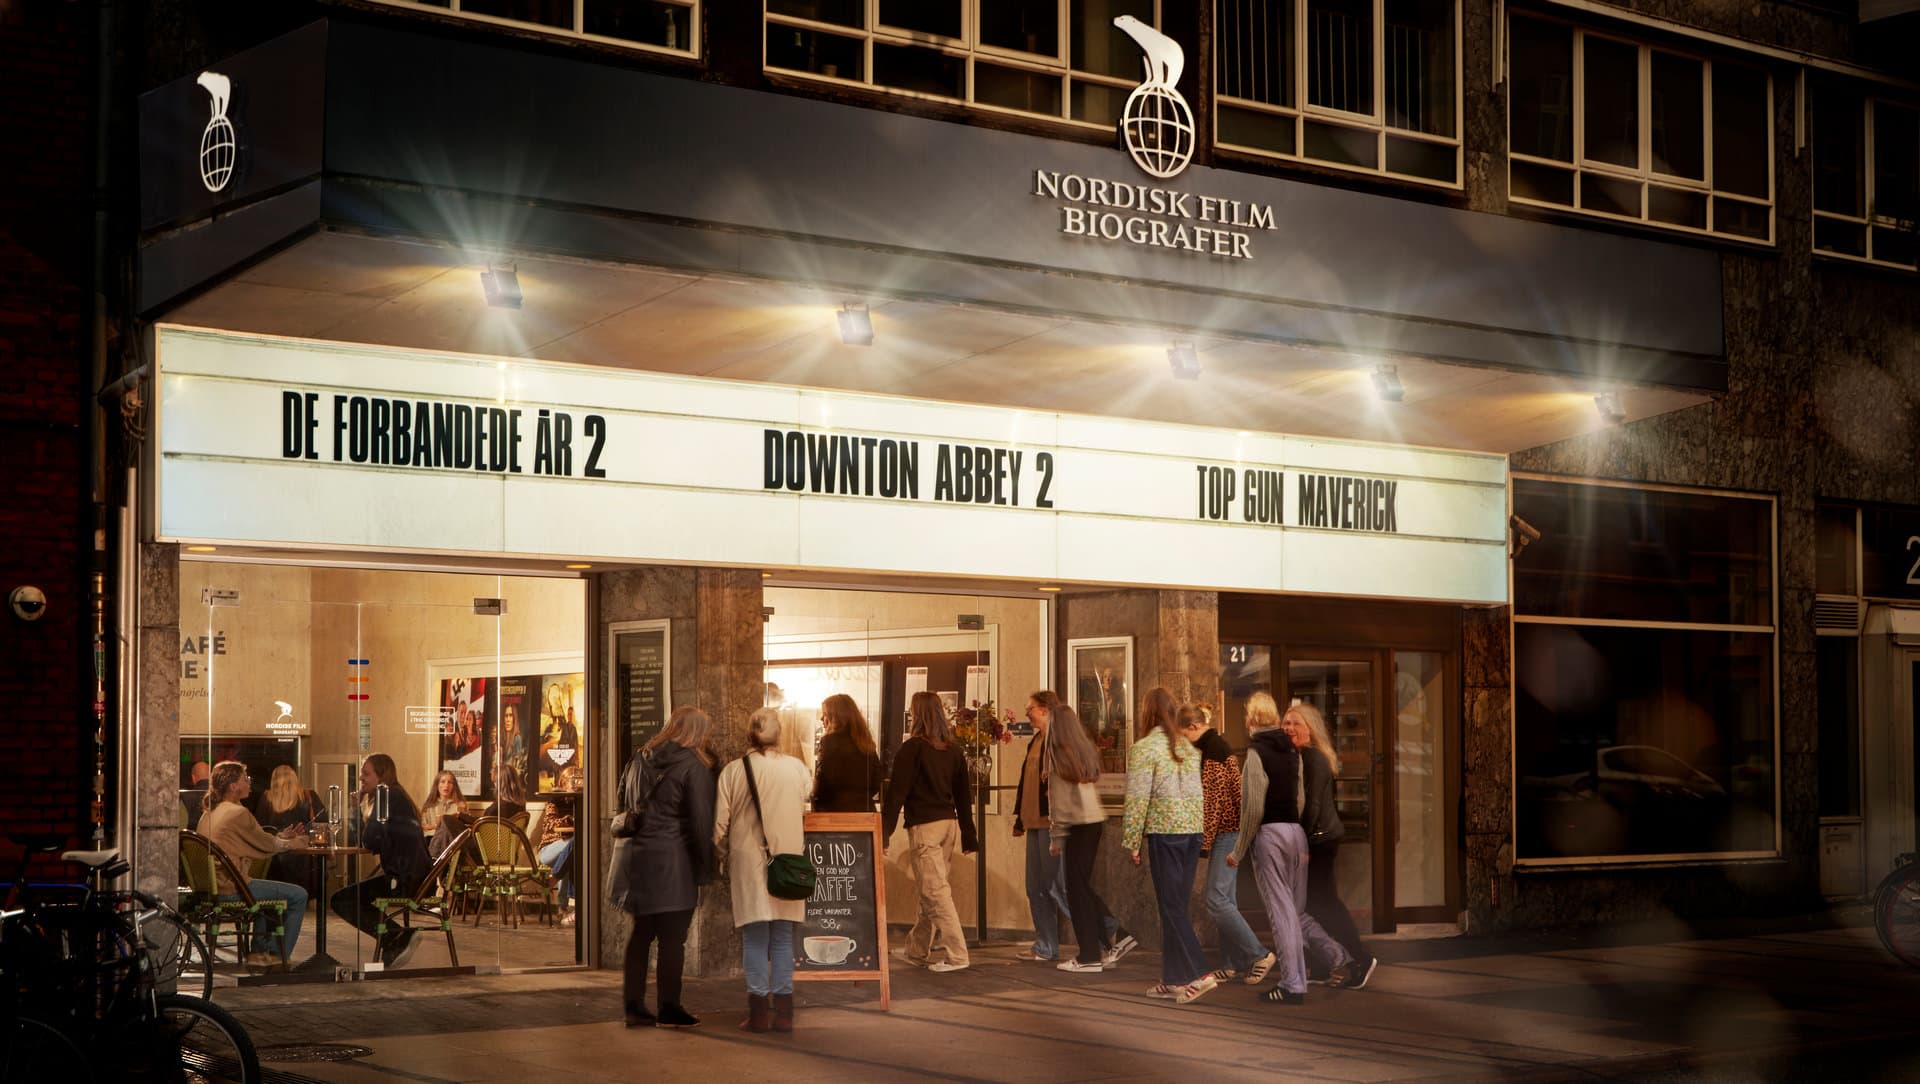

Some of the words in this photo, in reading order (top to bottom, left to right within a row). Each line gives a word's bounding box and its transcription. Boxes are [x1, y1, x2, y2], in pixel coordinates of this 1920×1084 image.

[1035, 169, 1191, 219] NORDISK
[1199, 195, 1278, 230] FILM
[1063, 206, 1253, 259] BIOGRAFER
[282, 390, 319, 460] DE
[333, 394, 522, 473] FORBANDEDE
[534, 408, 573, 477] ÅR
[583, 414, 606, 478] 2
[763, 428, 919, 500] DOWNTON
[934, 443, 1023, 507] ABBEY
[1035, 451, 1054, 508] 2
[1196, 465, 1236, 521] TOP
[1243, 469, 1284, 524] GUN
[1298, 473, 1398, 532] MAVERICK
[180, 630, 226, 655] AFÉ
[1230, 645, 1246, 663] 21
[808, 842, 823, 866] IG
[829, 842, 856, 867] IND
[826, 867, 838, 875] GOD
[838, 867, 850, 875] KOP
[807, 876, 857, 902] AFFE
